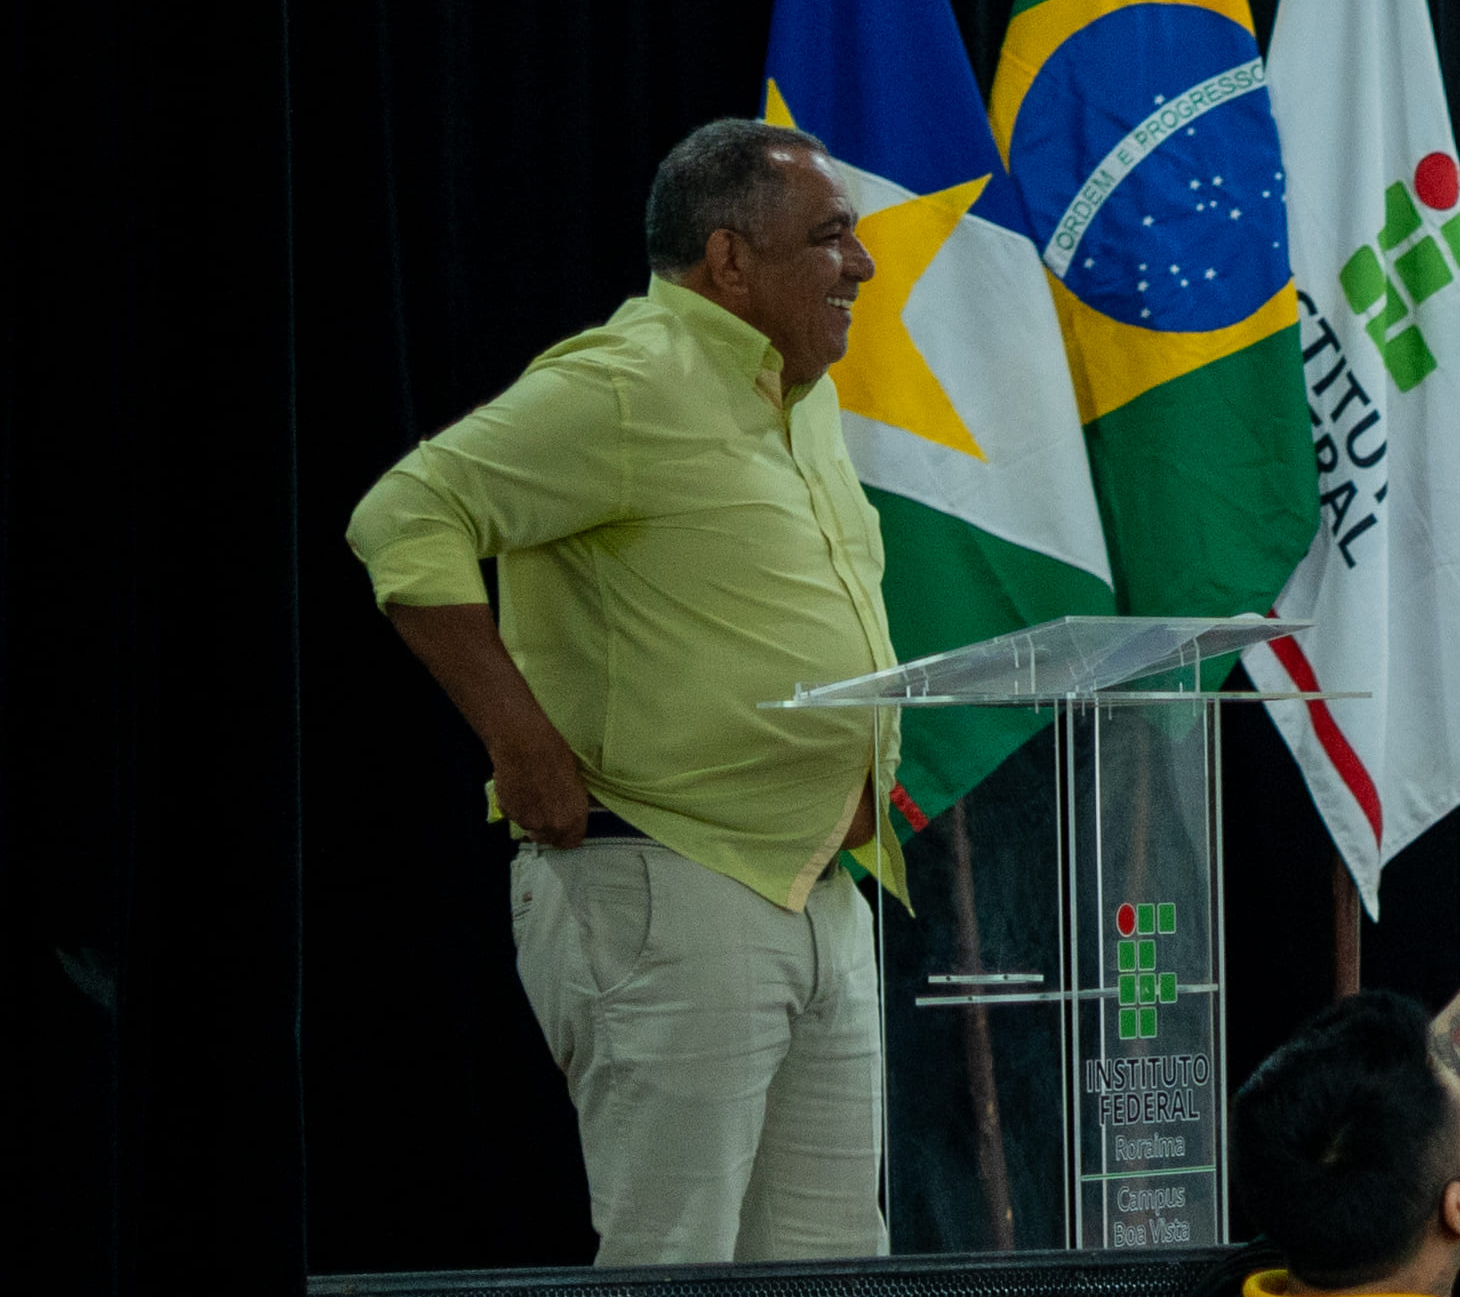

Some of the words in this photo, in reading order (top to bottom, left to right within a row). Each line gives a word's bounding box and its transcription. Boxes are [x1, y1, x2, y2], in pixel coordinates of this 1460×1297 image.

[1056, 170, 1116, 250] ORDEM
[1117, 148, 1135, 166] E
[1086, 1053, 1210, 1093] INSTITUTO
[1100, 1089, 1200, 1126] FEDERAL
[1115, 1132, 1185, 1161] Roraima
[1117, 1186, 1186, 1215] Campus
[1113, 1221, 1147, 1248] Boa
[1149, 1218, 1190, 1244] Vista
